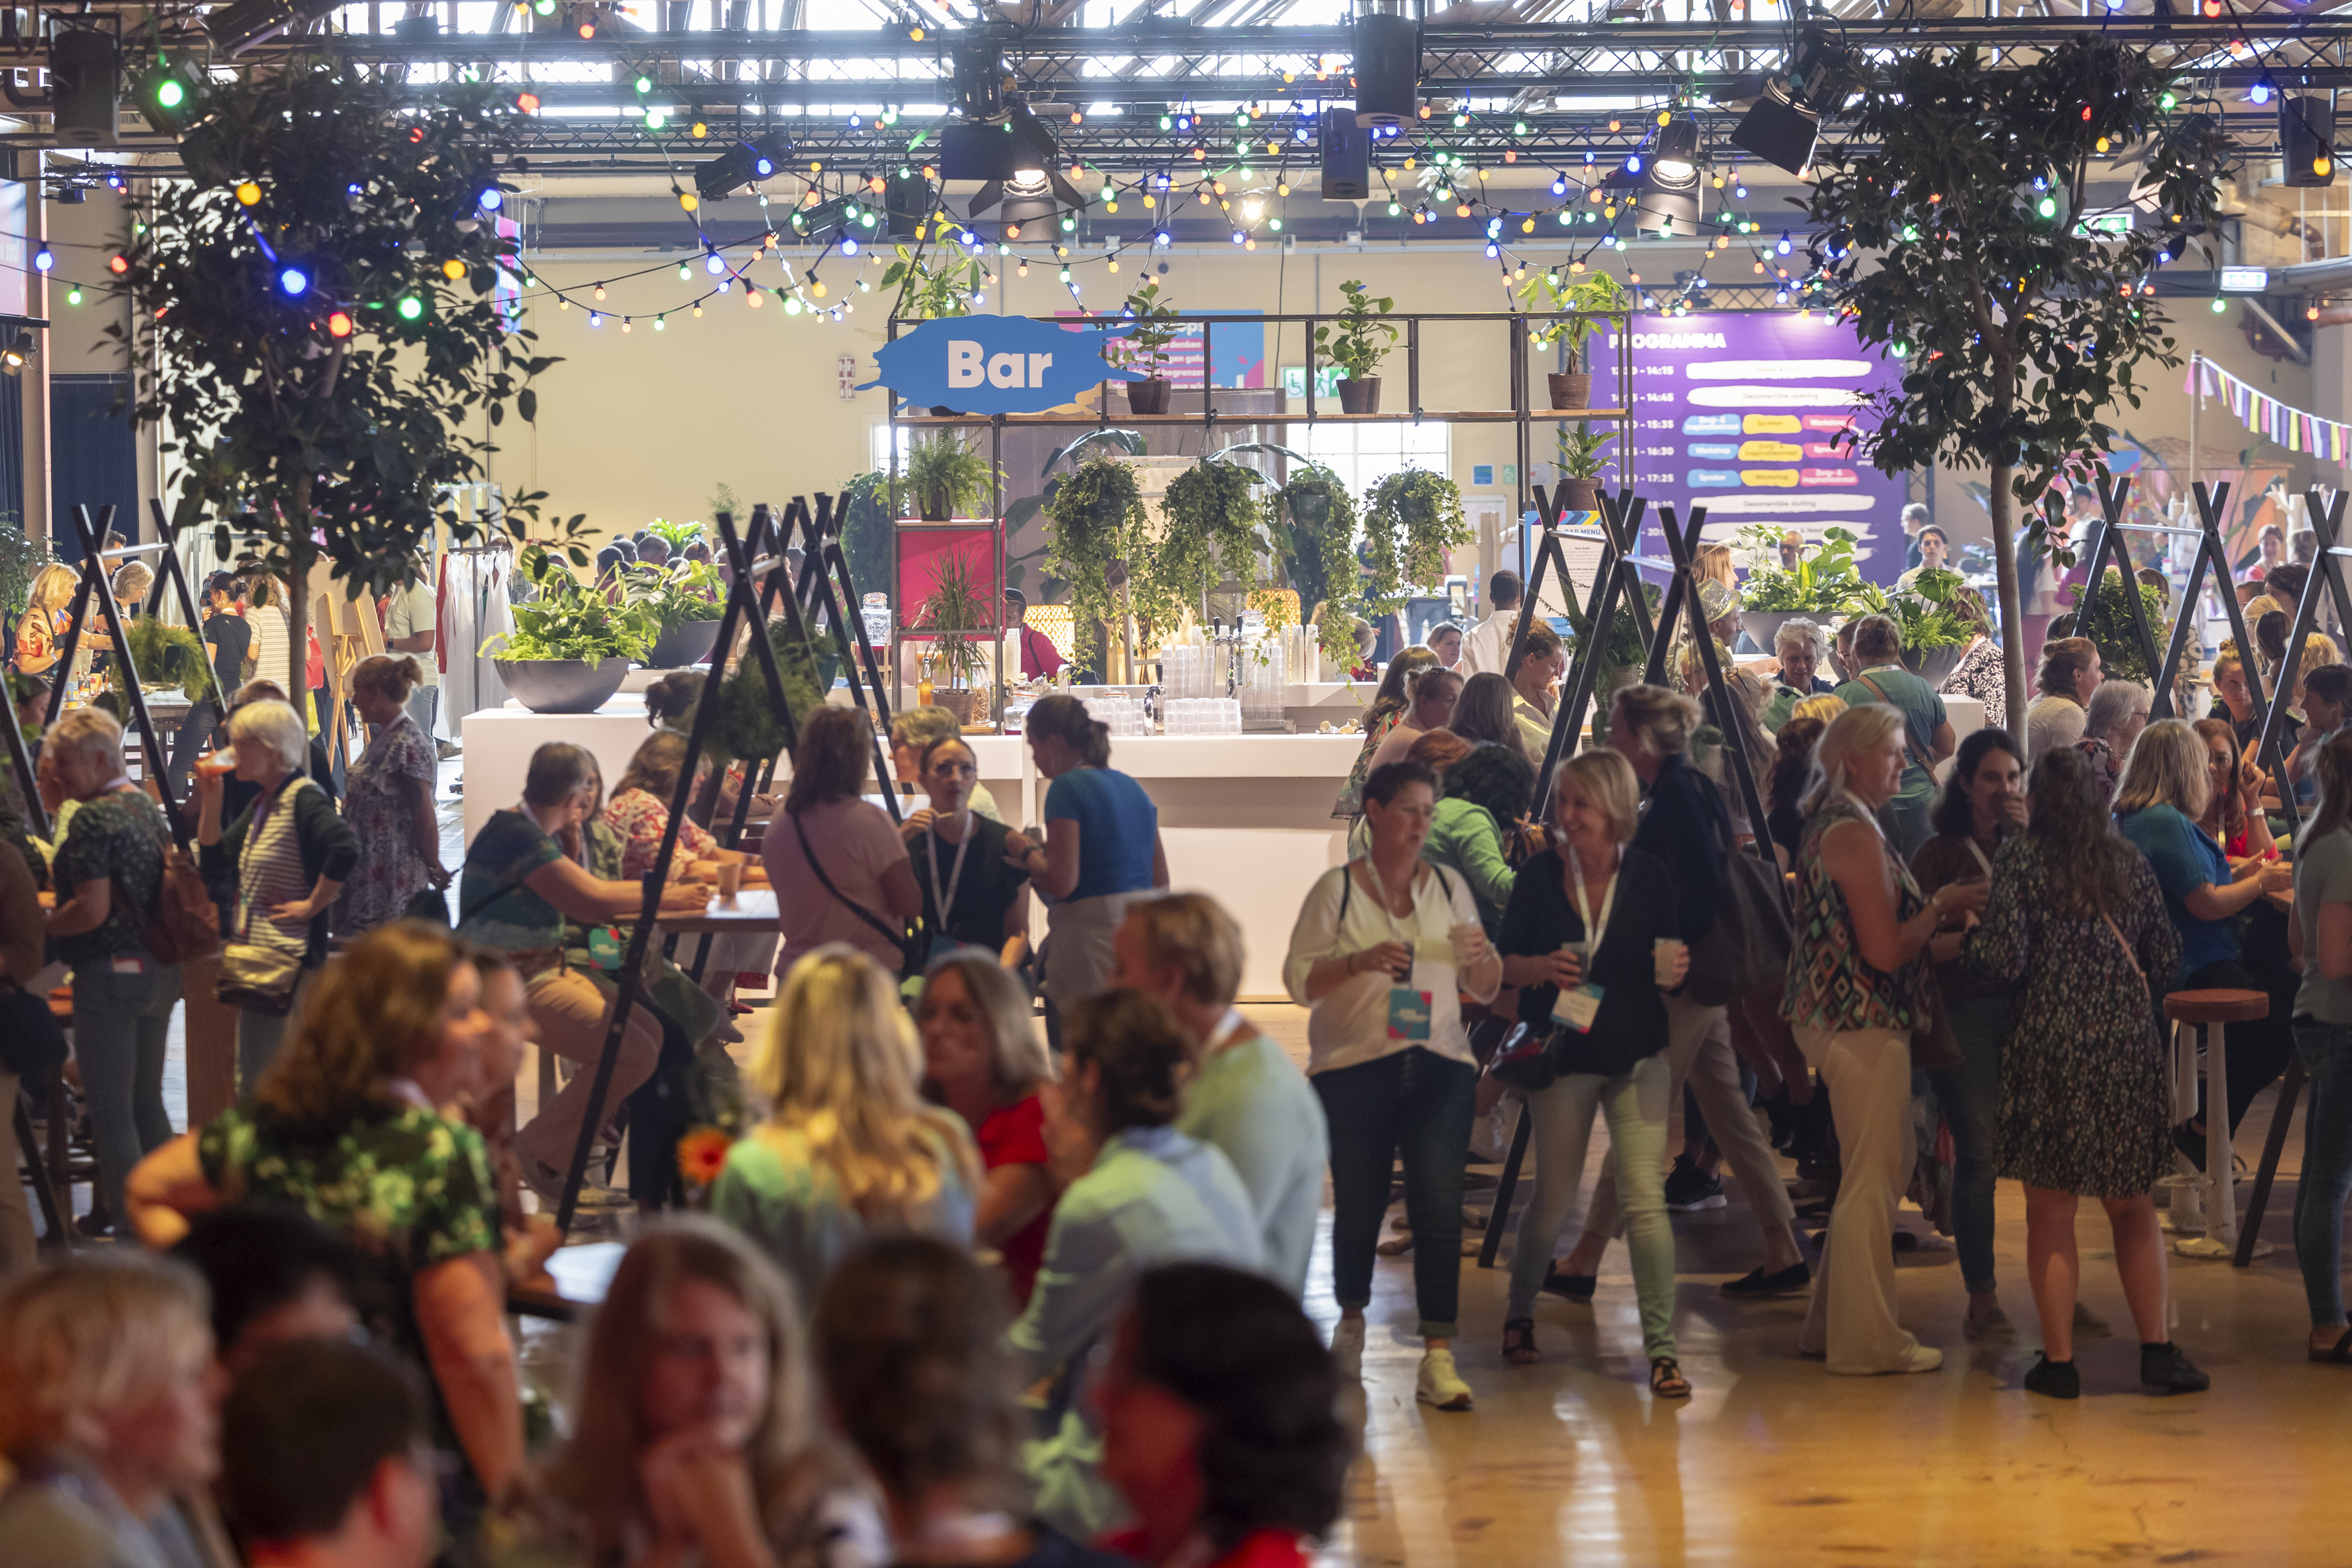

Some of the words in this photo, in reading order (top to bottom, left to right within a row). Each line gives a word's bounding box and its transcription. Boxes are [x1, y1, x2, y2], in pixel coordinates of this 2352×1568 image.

[948, 340, 1052, 388] Bar
[1161, 368, 1205, 378] begrenze
[1646, 366, 1674, 376] 14:15
[1646, 392, 1674, 402] 14:45
[1646, 420, 1674, 430] 15:35
[1646, 447, 1674, 456] 16:30
[1646, 473, 1674, 483] 17:25
